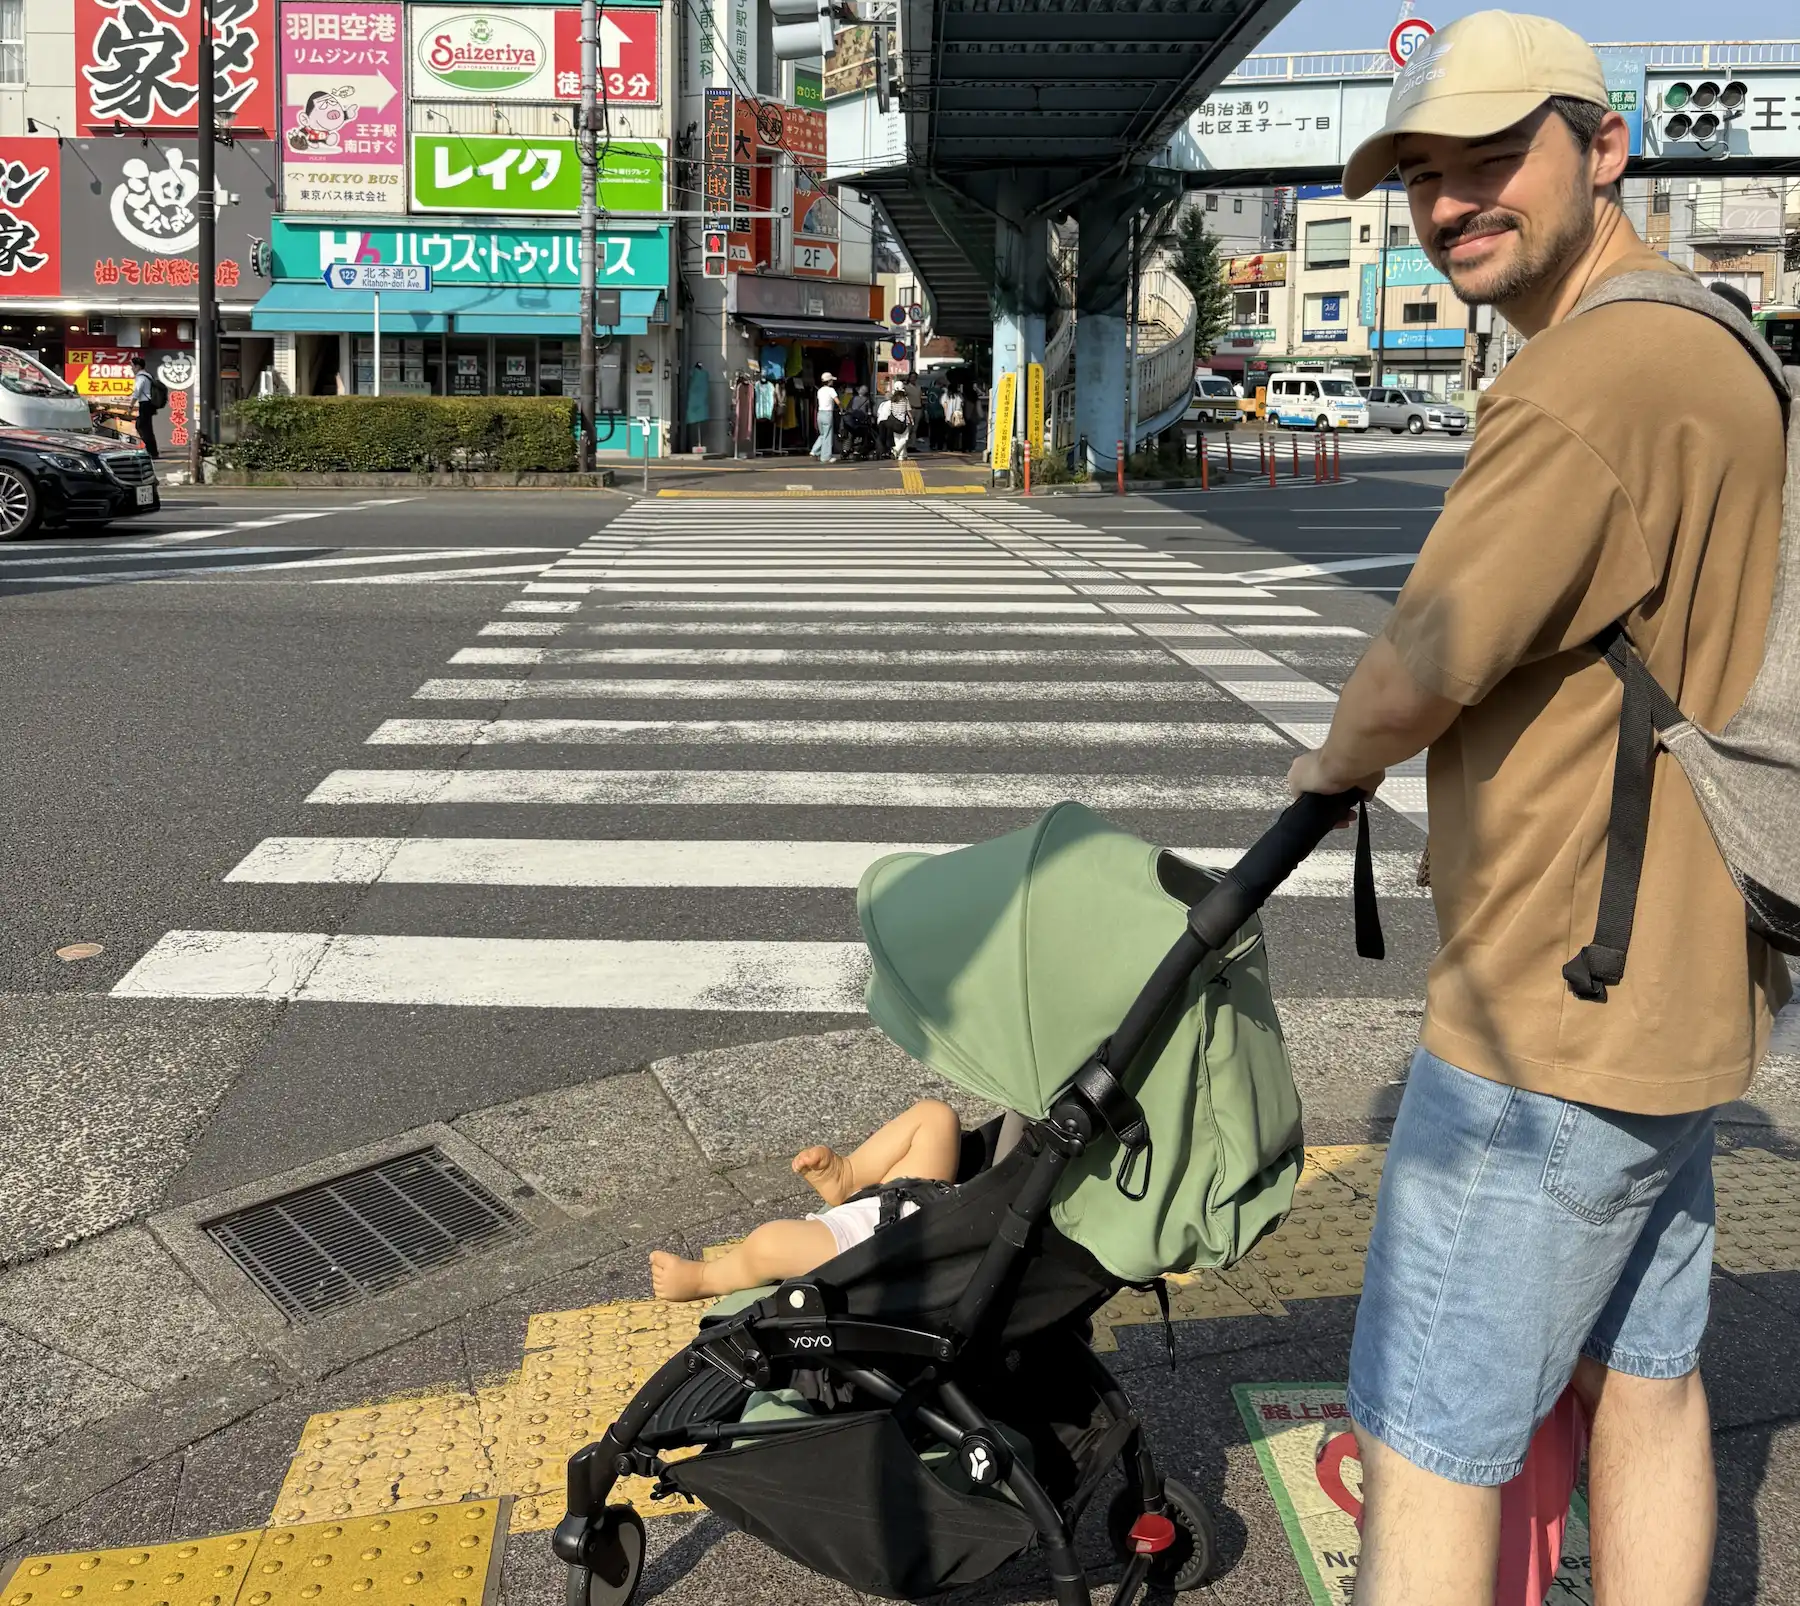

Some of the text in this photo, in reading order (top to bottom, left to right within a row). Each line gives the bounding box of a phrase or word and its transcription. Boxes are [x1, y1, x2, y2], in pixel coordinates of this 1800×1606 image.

[286, 13, 397, 43] 羽田空港
[699, 0, 715, 79] 前歯科
[294, 48, 390, 65] リムジンバス
[431, 34, 536, 66] Saizeriya
[82, 0, 200, 123] 家
[804, 88, 823, 100] 03-
[1608, 91, 1636, 103] 都高
[1198, 100, 1269, 117] 明治通り
[1750, 96, 1800, 131] 王
[356, 124, 397, 137] 王子駅
[1197, 116, 1330, 135] 北区王子一丁目
[344, 139, 396, 154] 南口すぐ
[434, 146, 562, 191] レイク
[0, 158, 49, 209] ン
[309, 173, 398, 184] TOKYO BUS
[733, 129, 752, 233] 大黒屋
[300, 190, 387, 202] 東京バス株式会社
[0, 208, 49, 277] 家
[730, 248, 747, 259] 入口
[804, 249, 821, 267] 2F
[95, 258, 240, 287] 油そば総店
[341, 270, 355, 280] 122
[364, 268, 417, 280] 北本通り
[362, 279, 422, 289] Kitahon-dori Ave.
[72, 352, 89, 362] 2F
[169, 390, 188, 446] 総本店
[789, 1335, 832, 1348] YOYO
[1322, 1551, 1361, 1568] No
